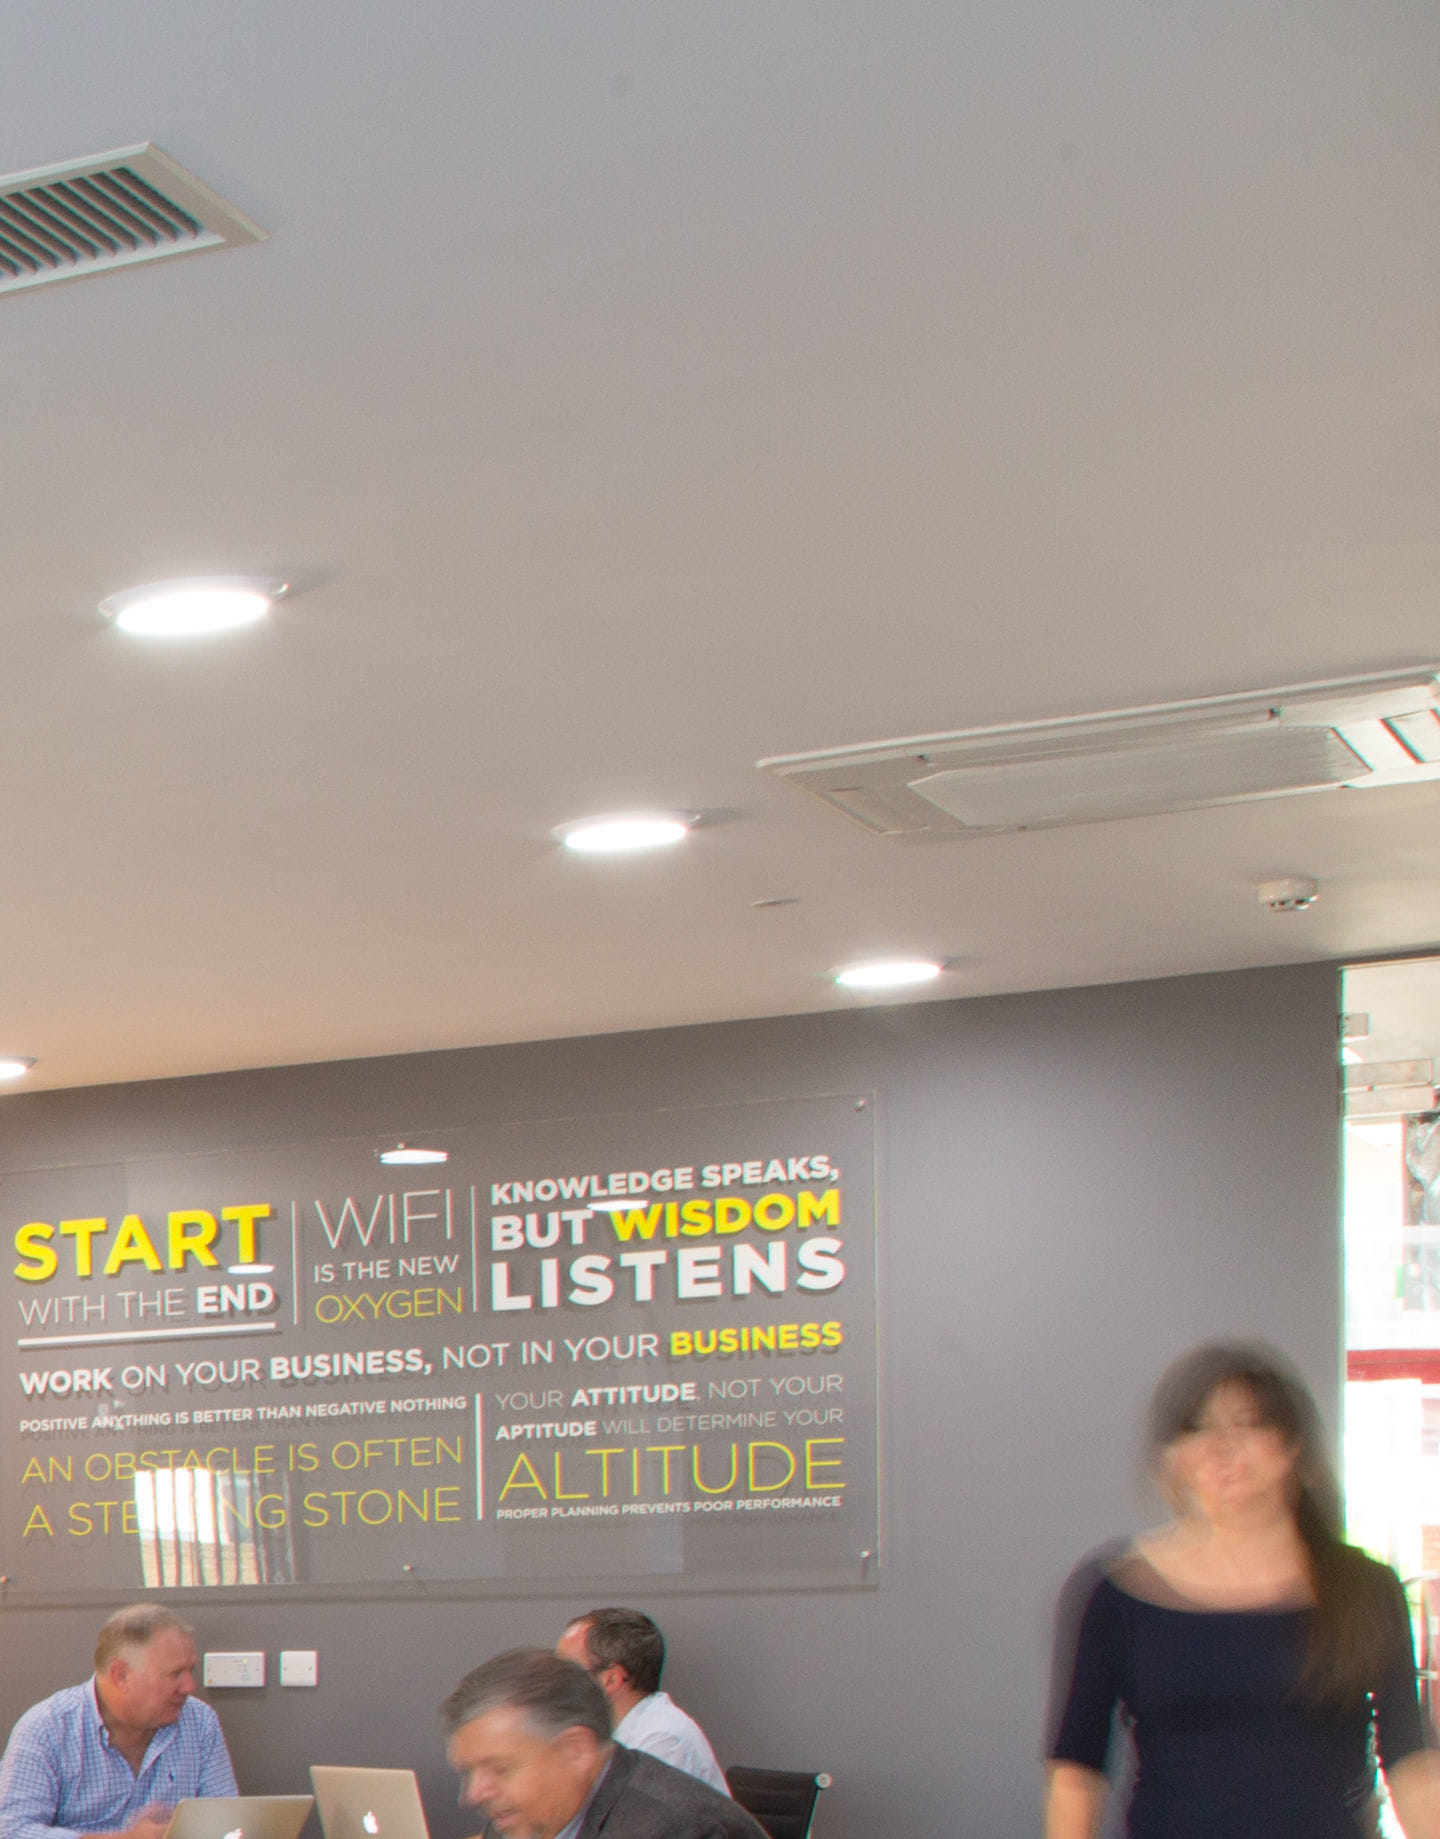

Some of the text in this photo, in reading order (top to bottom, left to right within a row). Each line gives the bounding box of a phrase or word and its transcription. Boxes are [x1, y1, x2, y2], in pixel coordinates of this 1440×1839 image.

[490, 1154, 841, 1206] KNOWLEDGE SPEAKS,
[13, 1202, 272, 1281] START
[314, 1188, 453, 1250] WIFI
[490, 1188, 841, 1251] BUT WISDOM
[313, 1253, 460, 1284] IS THE NEW
[490, 1236, 845, 1312] LISTENS
[18, 1281, 275, 1326] WITH THE END
[314, 1286, 464, 1324] OXYGEN
[19, 1320, 844, 1395] WORK ON YOUR BUSINESS, NOT IN YOUR BUSINESS
[19, 1395, 467, 1434] POSITIVE ANYTHING IS BETTER THAN NEGATIVE NOTHING
[494, 1373, 845, 1412] YOUR ATTITUDE, NOT YOUR
[495, 1407, 845, 1441] APTITUDE WILL DETERMINE YOUR
[21, 1435, 463, 1484] AN OBSTACLE IS OFTEN
[498, 1436, 846, 1503] ALTITUDE
[23, 1486, 462, 1537] A STENG STONE
[496, 1495, 842, 1521] PROPER PLANNING PREVENTS POOR PERFORMANCE
